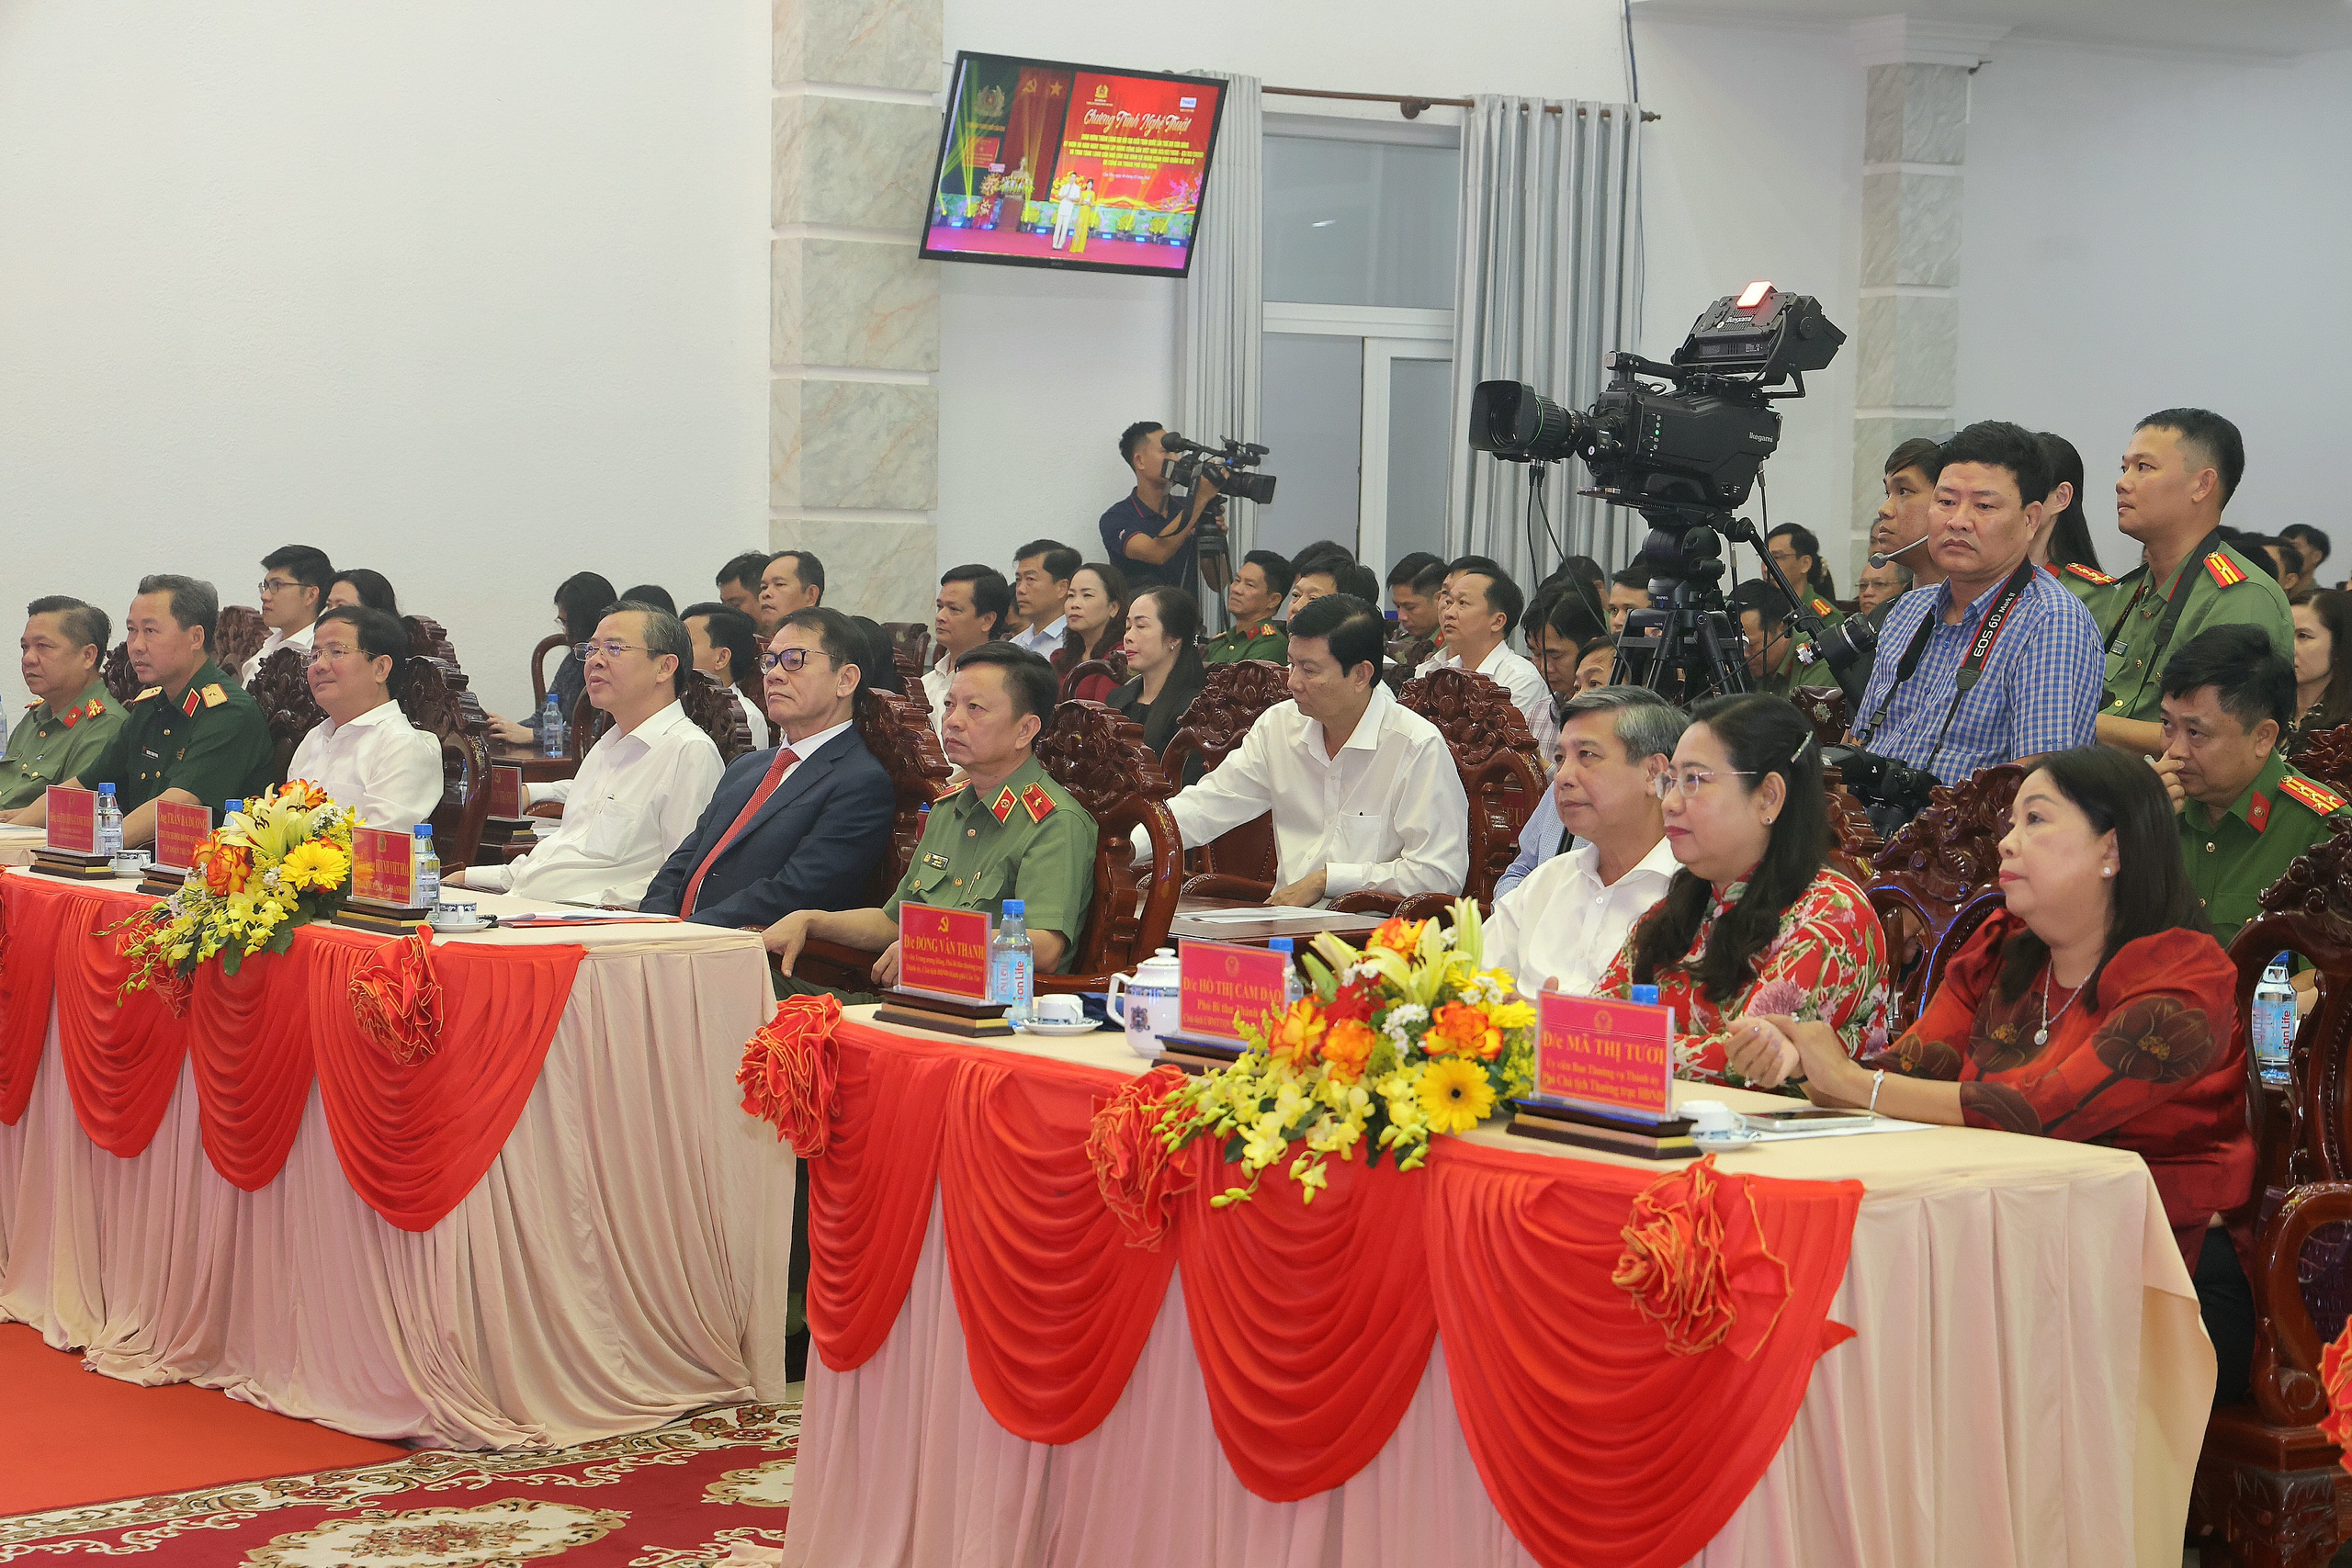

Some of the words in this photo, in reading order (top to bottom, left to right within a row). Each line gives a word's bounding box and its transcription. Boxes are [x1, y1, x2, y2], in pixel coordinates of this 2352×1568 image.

[1748, 431, 1773, 443] Ikegami
[1973, 629, 1994, 658] EOS
[1988, 615, 2002, 628] 6D
[1998, 596, 2013, 613] Mark
[956, 942, 984, 959] THANH
[1015, 961, 1024, 979] Life
[2281, 1010, 2290, 1029] Life
[1594, 1038, 1622, 1063] THỊ
